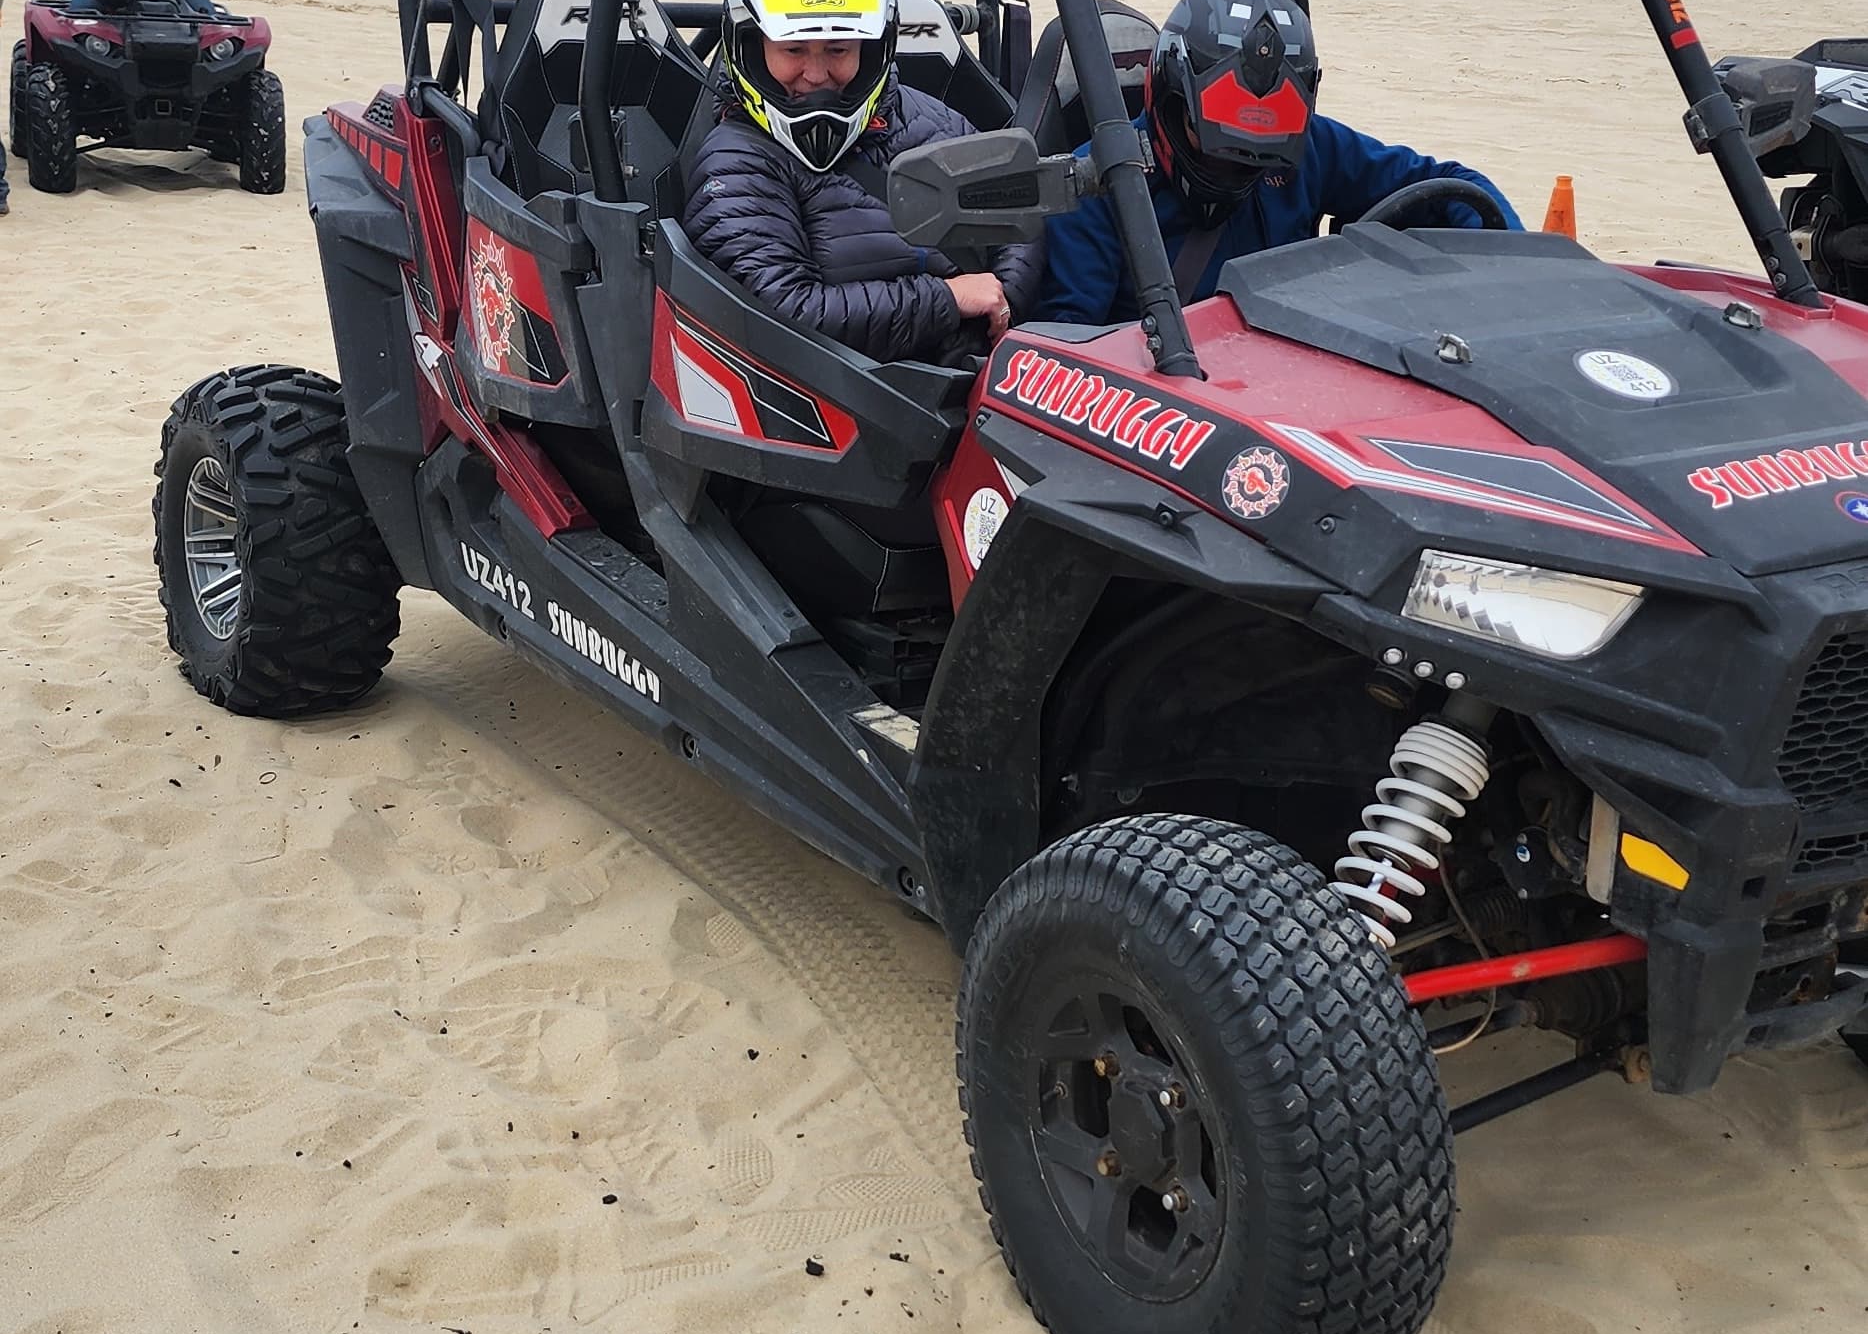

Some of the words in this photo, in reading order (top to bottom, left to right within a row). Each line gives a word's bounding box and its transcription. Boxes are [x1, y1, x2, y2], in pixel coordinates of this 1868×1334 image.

[995, 349, 1217, 471] SUNBUGGY
[1630, 381, 1663, 393] 412
[980, 494, 997, 515] UZ
[460, 541, 536, 621] UZ412
[547, 599, 661, 704] SUNBUGGY
